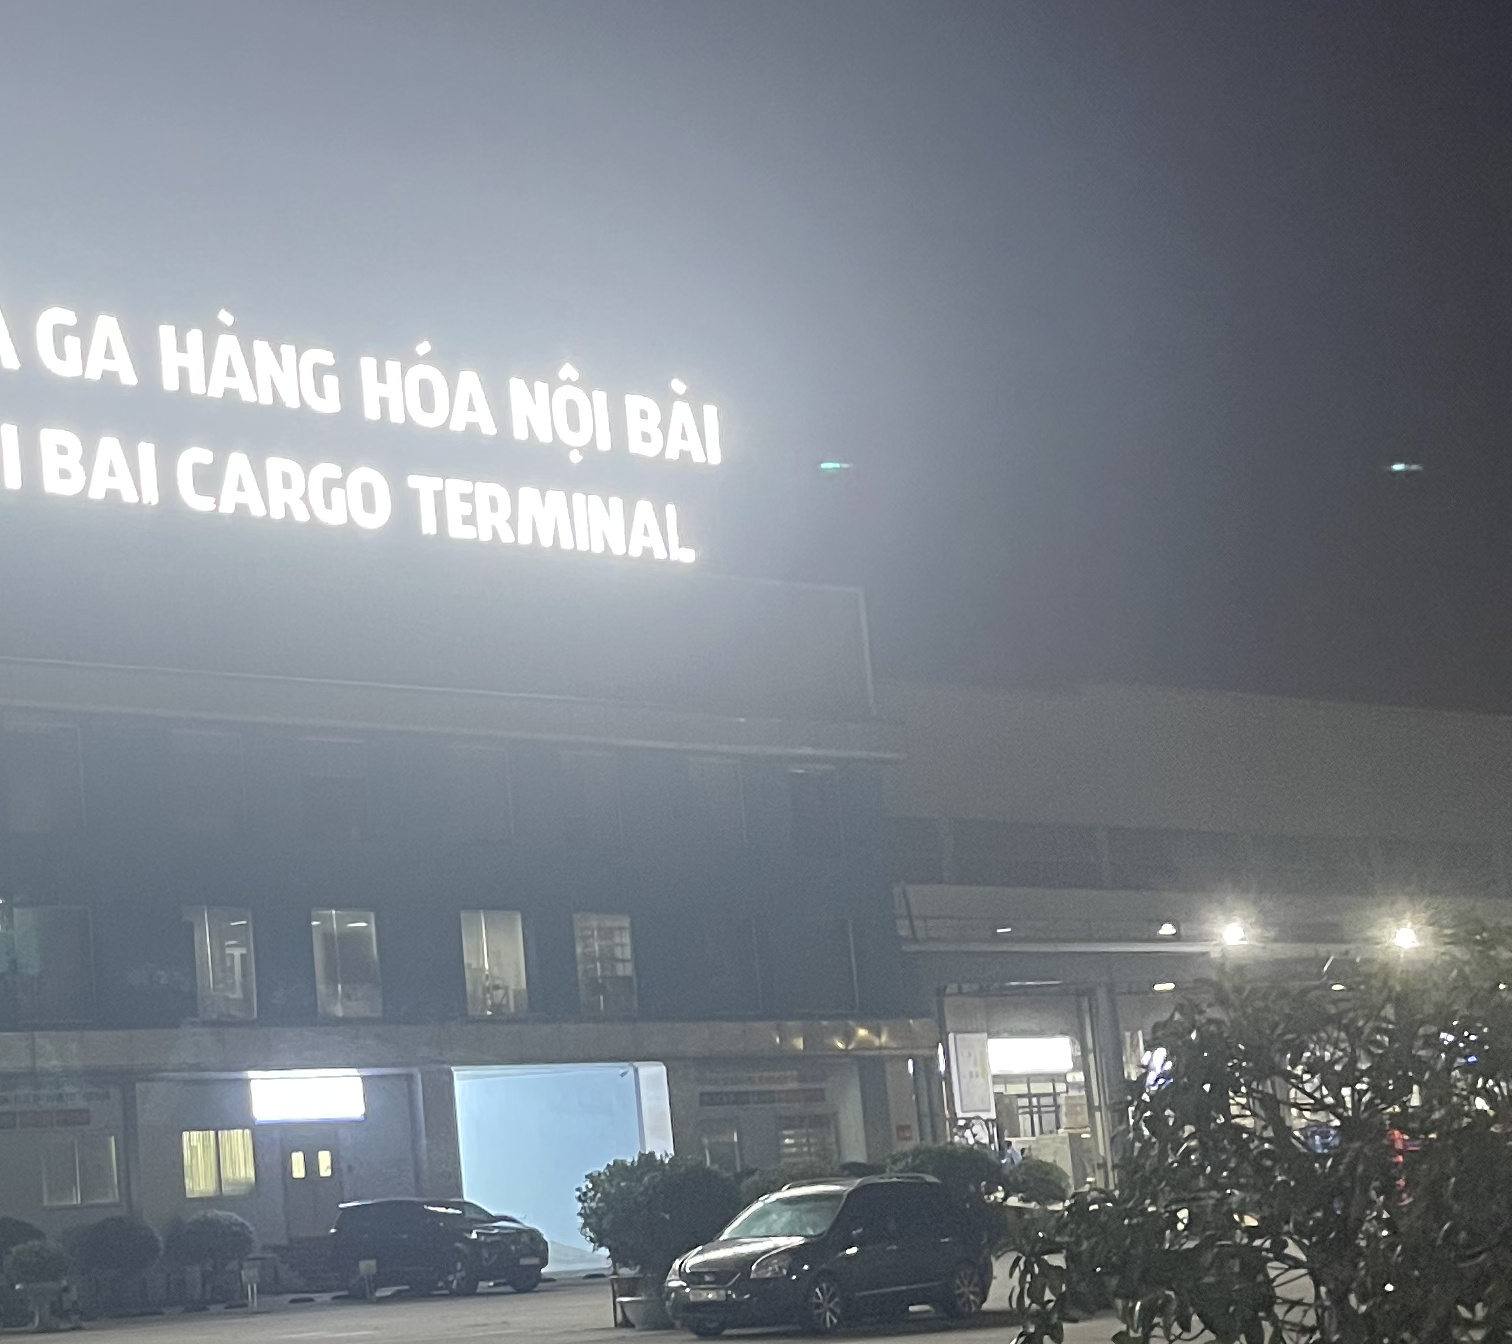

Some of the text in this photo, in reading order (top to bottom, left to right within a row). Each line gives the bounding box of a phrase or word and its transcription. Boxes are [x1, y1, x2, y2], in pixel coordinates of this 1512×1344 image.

[35, 306, 139, 386] GA
[158, 308, 342, 414] HÀNG
[360, 340, 498, 436] HÓA
[509, 362, 612, 464] NỘI
[624, 378, 722, 465] BÀI
[39, 428, 159, 506] BAI
[176, 446, 392, 530] CARGO
[407, 474, 696, 563] TERMINAL
